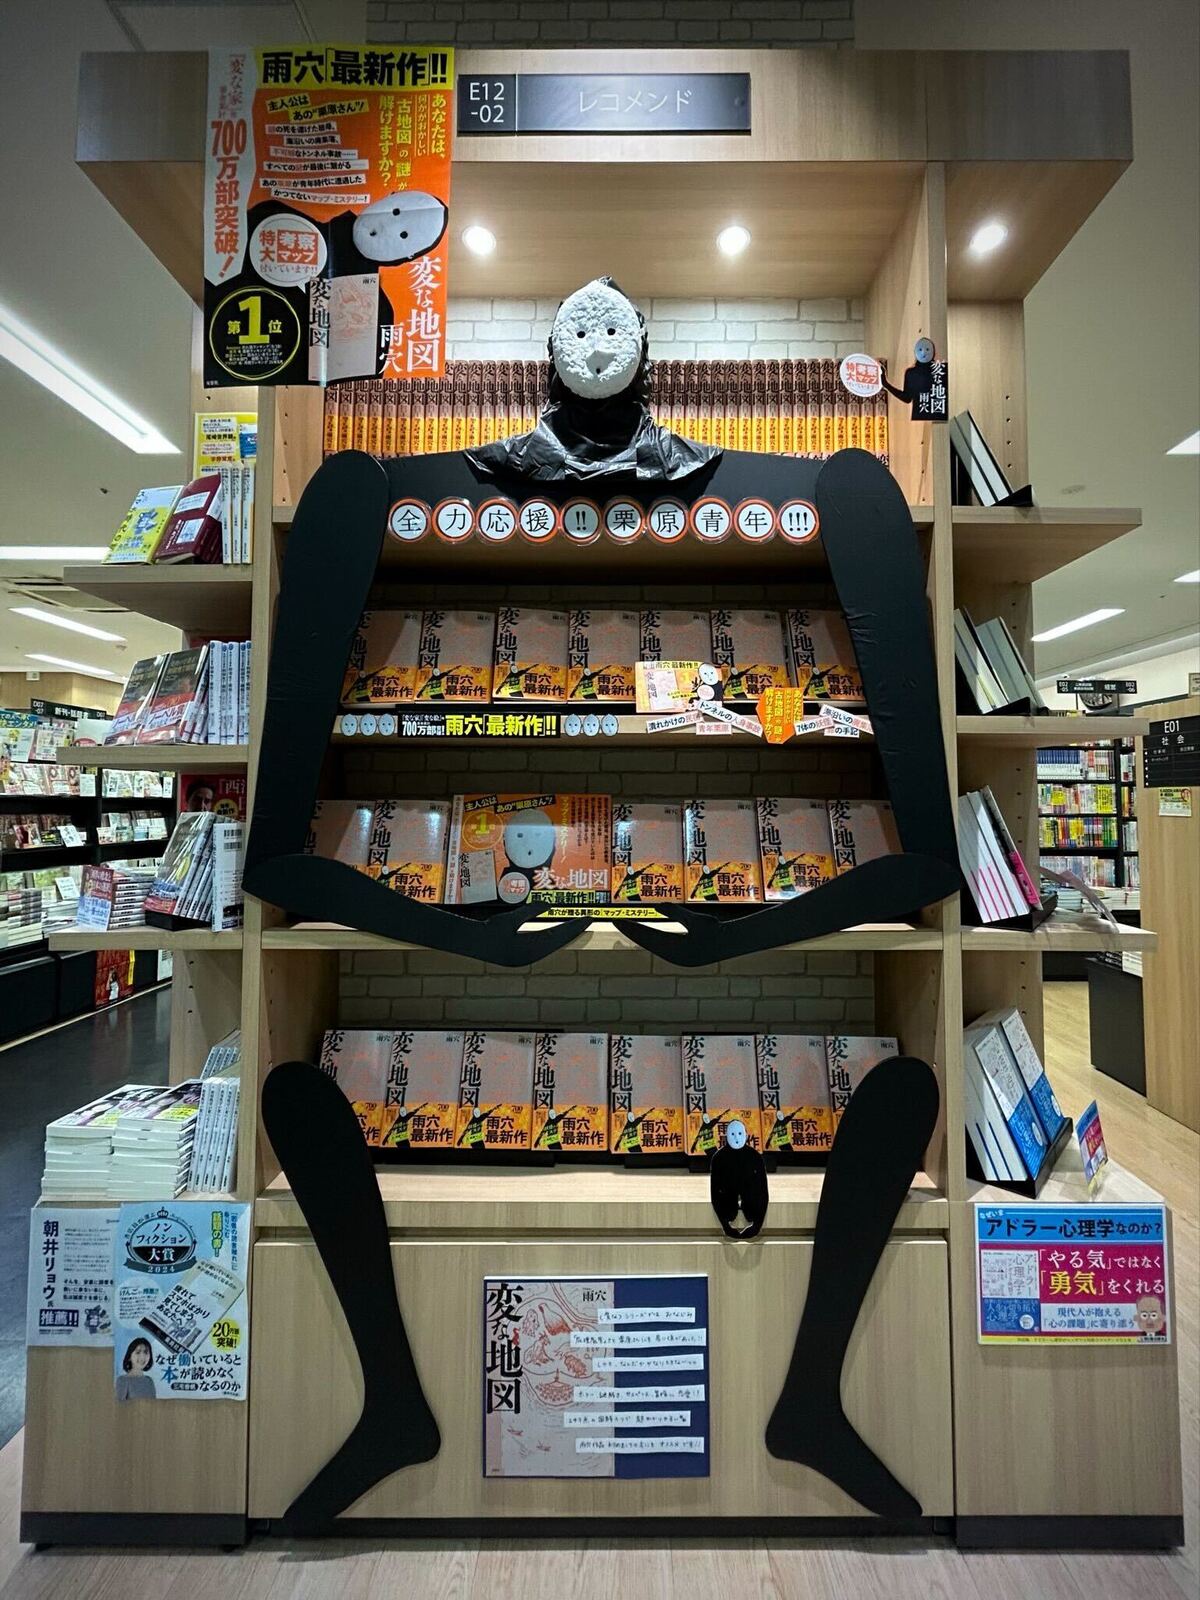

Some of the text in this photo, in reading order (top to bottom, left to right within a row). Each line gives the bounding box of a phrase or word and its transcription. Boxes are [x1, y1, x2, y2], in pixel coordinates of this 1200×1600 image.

[262, 48, 448, 87] 雨穴「最新作」!!
[469, 82, 505, 102] E12
[268, 95, 309, 111] 主人公は
[579, 89, 693, 114] レコメンド
[470, 104, 505, 124] -02
[432, 93, 447, 159] あなたは、
[378, 95, 395, 187] 解けますか?
[228, 296, 282, 344] 第1位
[309, 278, 331, 349] 変な地図
[407, 256, 442, 373] 変な地図
[379, 323, 404, 374] 雨穴
[930, 360, 946, 414] 変な地図
[919, 392, 930, 414] 雨穴
[419, 610, 446, 670] 変な地図
[496, 607, 520, 666] 変な地図
[568, 610, 590, 670] 変な地図
[712, 610, 734, 667] 変な地図
[790, 608, 816, 668] 変な地図
[371, 675, 400, 686] 雨穴
[446, 674, 474, 685] 雨穴
[524, 672, 552, 684] 雨穴
[598, 674, 625, 685] 雨穴
[746, 674, 772, 685] 雨穴
[828, 674, 853, 685] 雨穴
[370, 686, 414, 698] 最新作
[444, 686, 488, 696] 最新作
[523, 686, 566, 696] 最新作
[597, 684, 636, 696] 最新作
[445, 714, 557, 737] 雨穴「最新作」!!
[1164, 720, 1180, 734] E01
[465, 796, 498, 811] 主人公は
[368, 800, 396, 866] 変な地図
[612, 804, 632, 866] 変地図
[830, 800, 857, 867] 変な地図
[793, 863, 820, 876] 雨穴
[394, 872, 424, 885] 雨穴
[533, 867, 608, 890] 変な地図
[640, 874, 668, 886] 雨穴
[718, 872, 745, 885] 雨穴
[640, 886, 682, 898] 最新作
[718, 886, 760, 898] 最新作
[320, 1032, 344, 1084] 変な地
[385, 1032, 414, 1108] 変な地図
[459, 1032, 486, 1108] 変な地図
[534, 1034, 558, 1110] 変な地図
[612, 1036, 633, 1112] 変な地図
[684, 1036, 707, 1113] 変な地図
[758, 1036, 780, 1111] 変な地図
[412, 1116, 440, 1128] 雨穴
[486, 1116, 514, 1129] 雨穴
[562, 1117, 590, 1130] 雨穴
[642, 1120, 668, 1134] 雨穴
[790, 1118, 818, 1132] 雨穴
[410, 1128, 454, 1142] 最新作
[484, 1130, 528, 1144] 最新作
[562, 1131, 604, 1146] 最新作
[640, 1134, 682, 1148] 最新作
[790, 1132, 832, 1146] 最新作
[152, 1222, 172, 1232] ノン
[986, 1218, 1162, 1238] アドラー心理学なのか?
[136, 1234, 187, 1245] フィクション
[148, 1248, 175, 1262] 大賞
[1040, 1248, 1161, 1270] 「やる気」ではなく
[148, 1266, 176, 1274] 2024
[1040, 1270, 1165, 1296] 「勇気」をくれる
[582, 1288, 608, 1302] 雨穴
[486, 1283, 524, 1415] 変な地図
[156, 1354, 242, 1366] なぜ働いていると
[160, 1366, 234, 1384] 本が読めなく
[199, 1380, 242, 1392] なるのか
